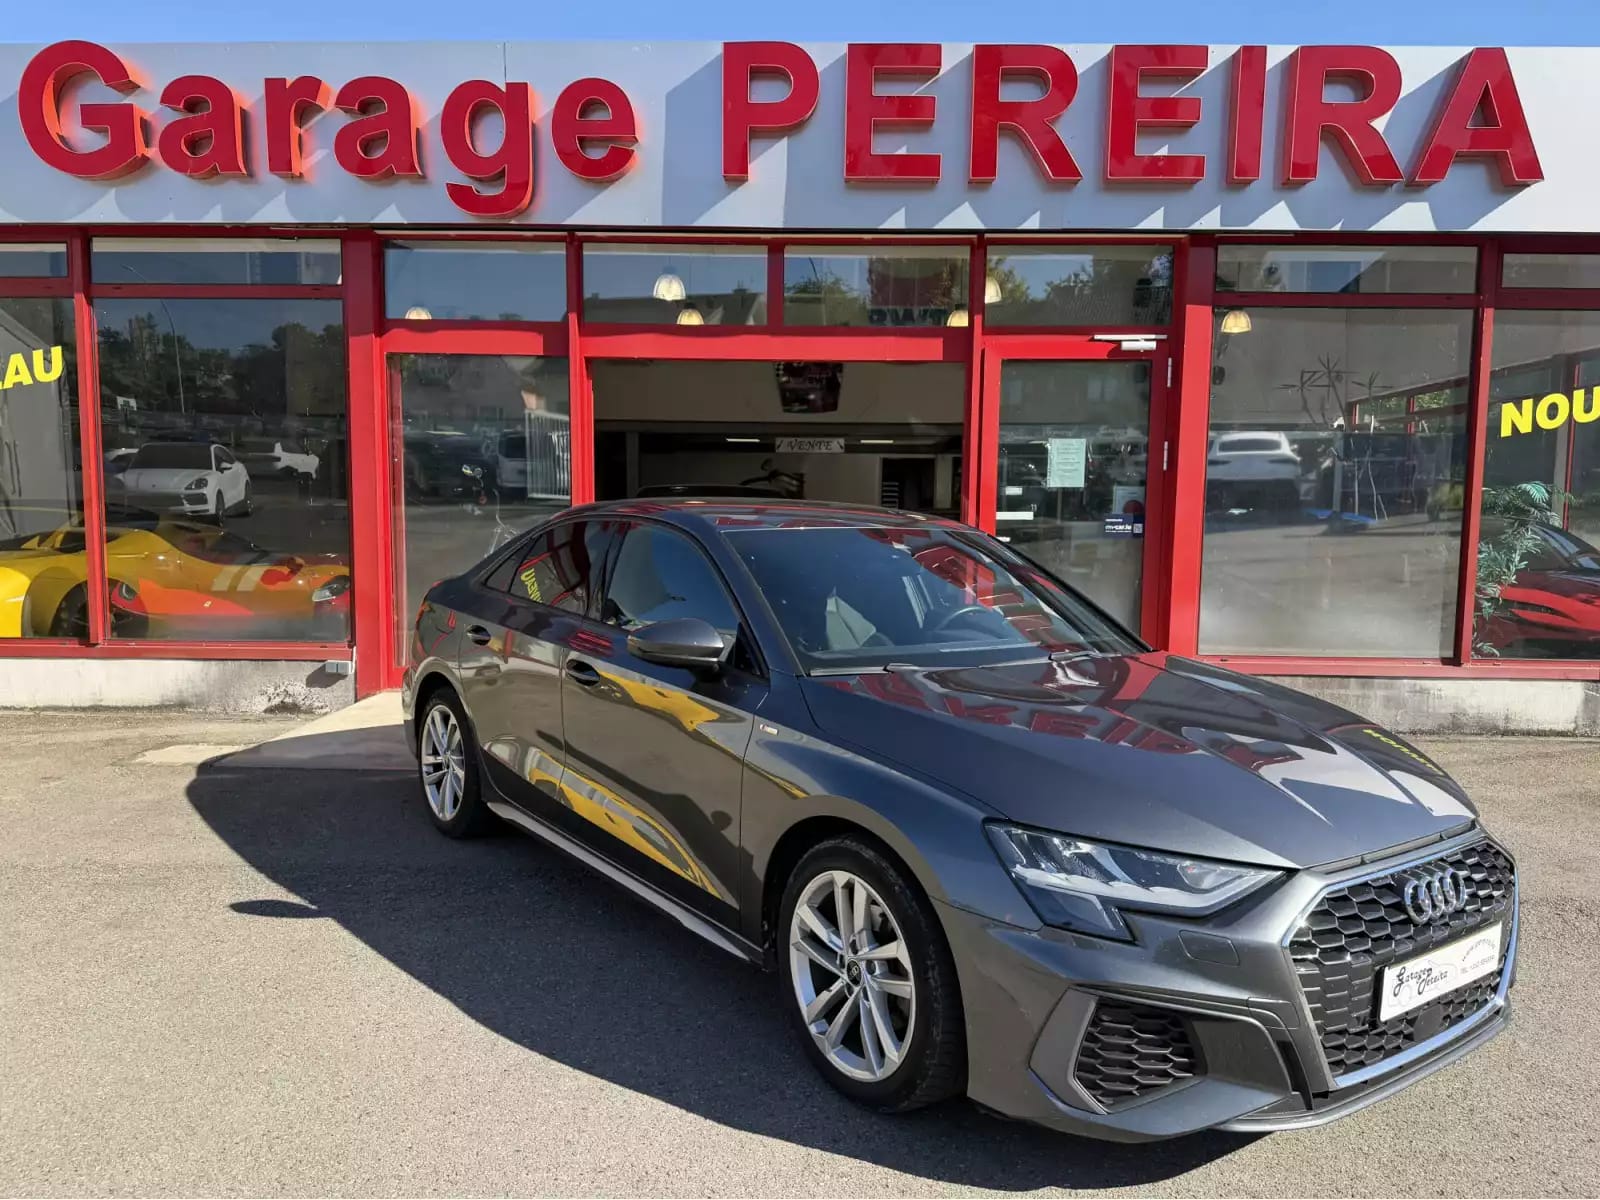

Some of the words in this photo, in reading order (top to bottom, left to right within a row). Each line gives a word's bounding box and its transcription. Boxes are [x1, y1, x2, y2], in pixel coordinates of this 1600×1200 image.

[18, 40, 638, 217] Garage
[722, 41, 1544, 187] PEREIRA
[1501, 385, 1600, 438] NOU
[786, 438, 833, 451] VENTE
